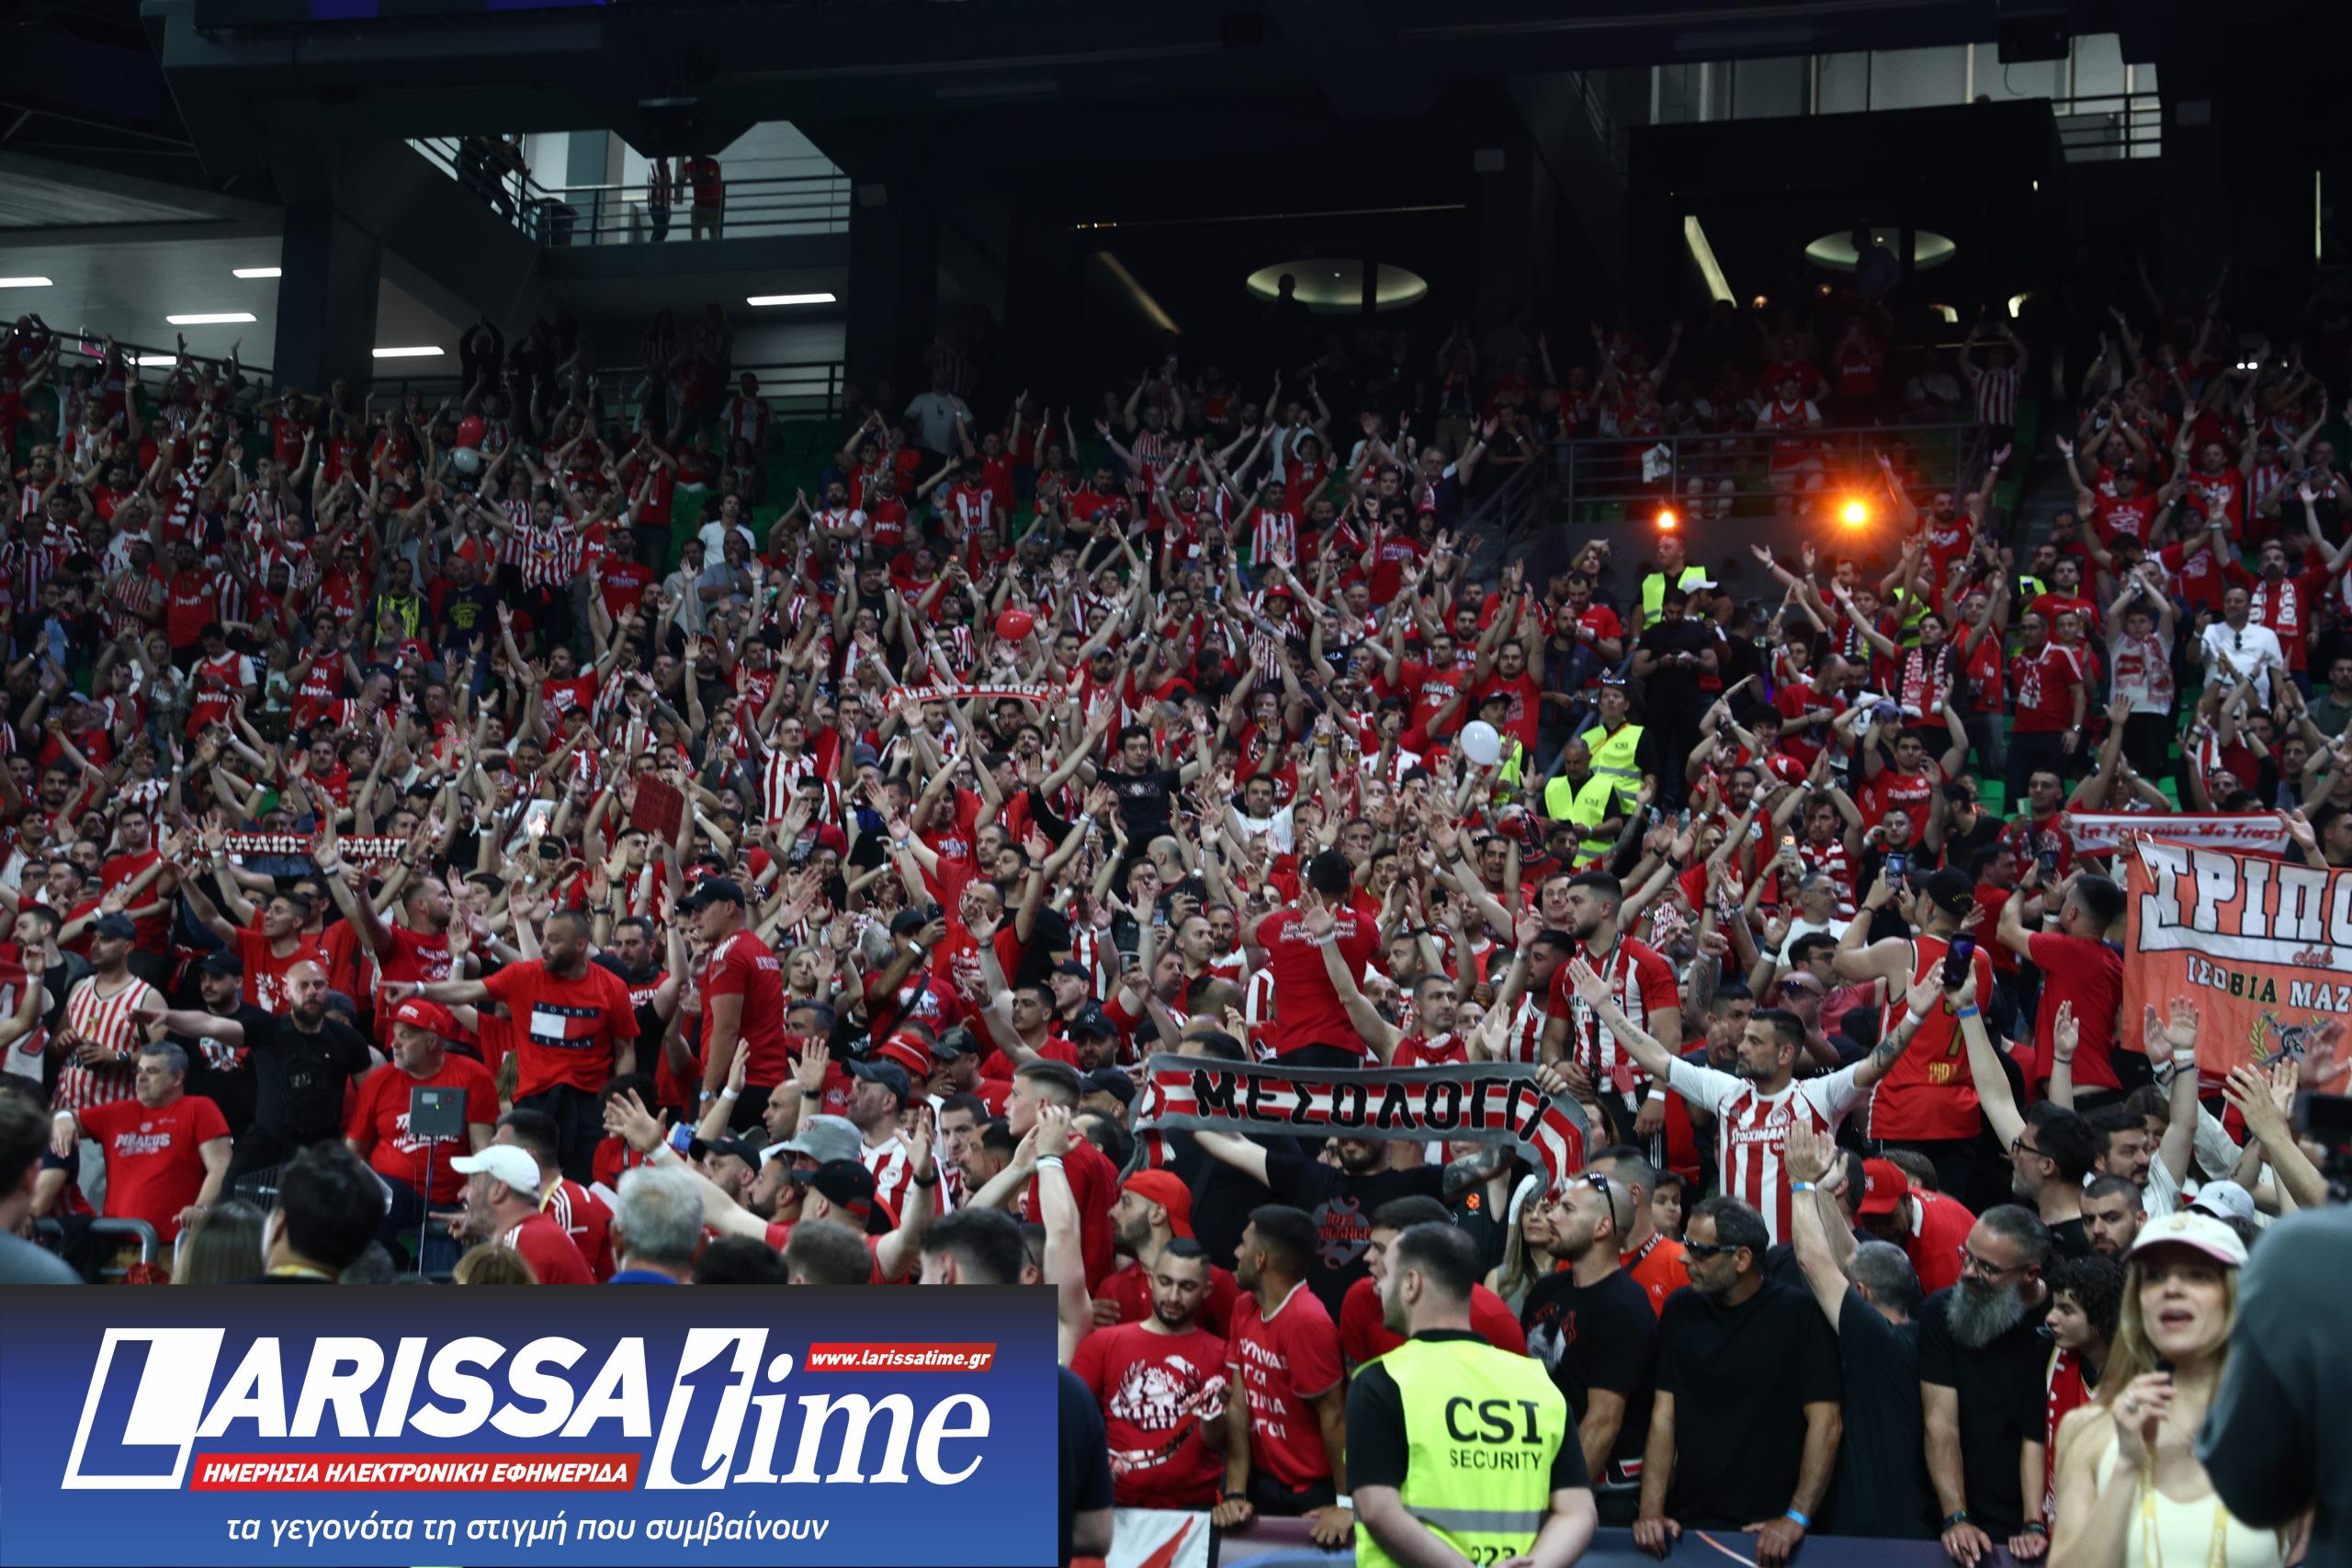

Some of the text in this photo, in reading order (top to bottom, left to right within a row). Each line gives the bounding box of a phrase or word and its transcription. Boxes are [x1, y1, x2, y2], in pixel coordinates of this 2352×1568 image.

[2233, 823, 2287, 841] Trust
[2292, 944, 2335, 966] club
[2186, 954, 2278, 1003] ΙΣΟΒΙΑ
[537, 1003, 597, 1018] TOMMY
[534, 1035, 593, 1048] JEANS
[1445, 1396, 1544, 1445] CSI
[1450, 1449, 1544, 1471] SECURITY
